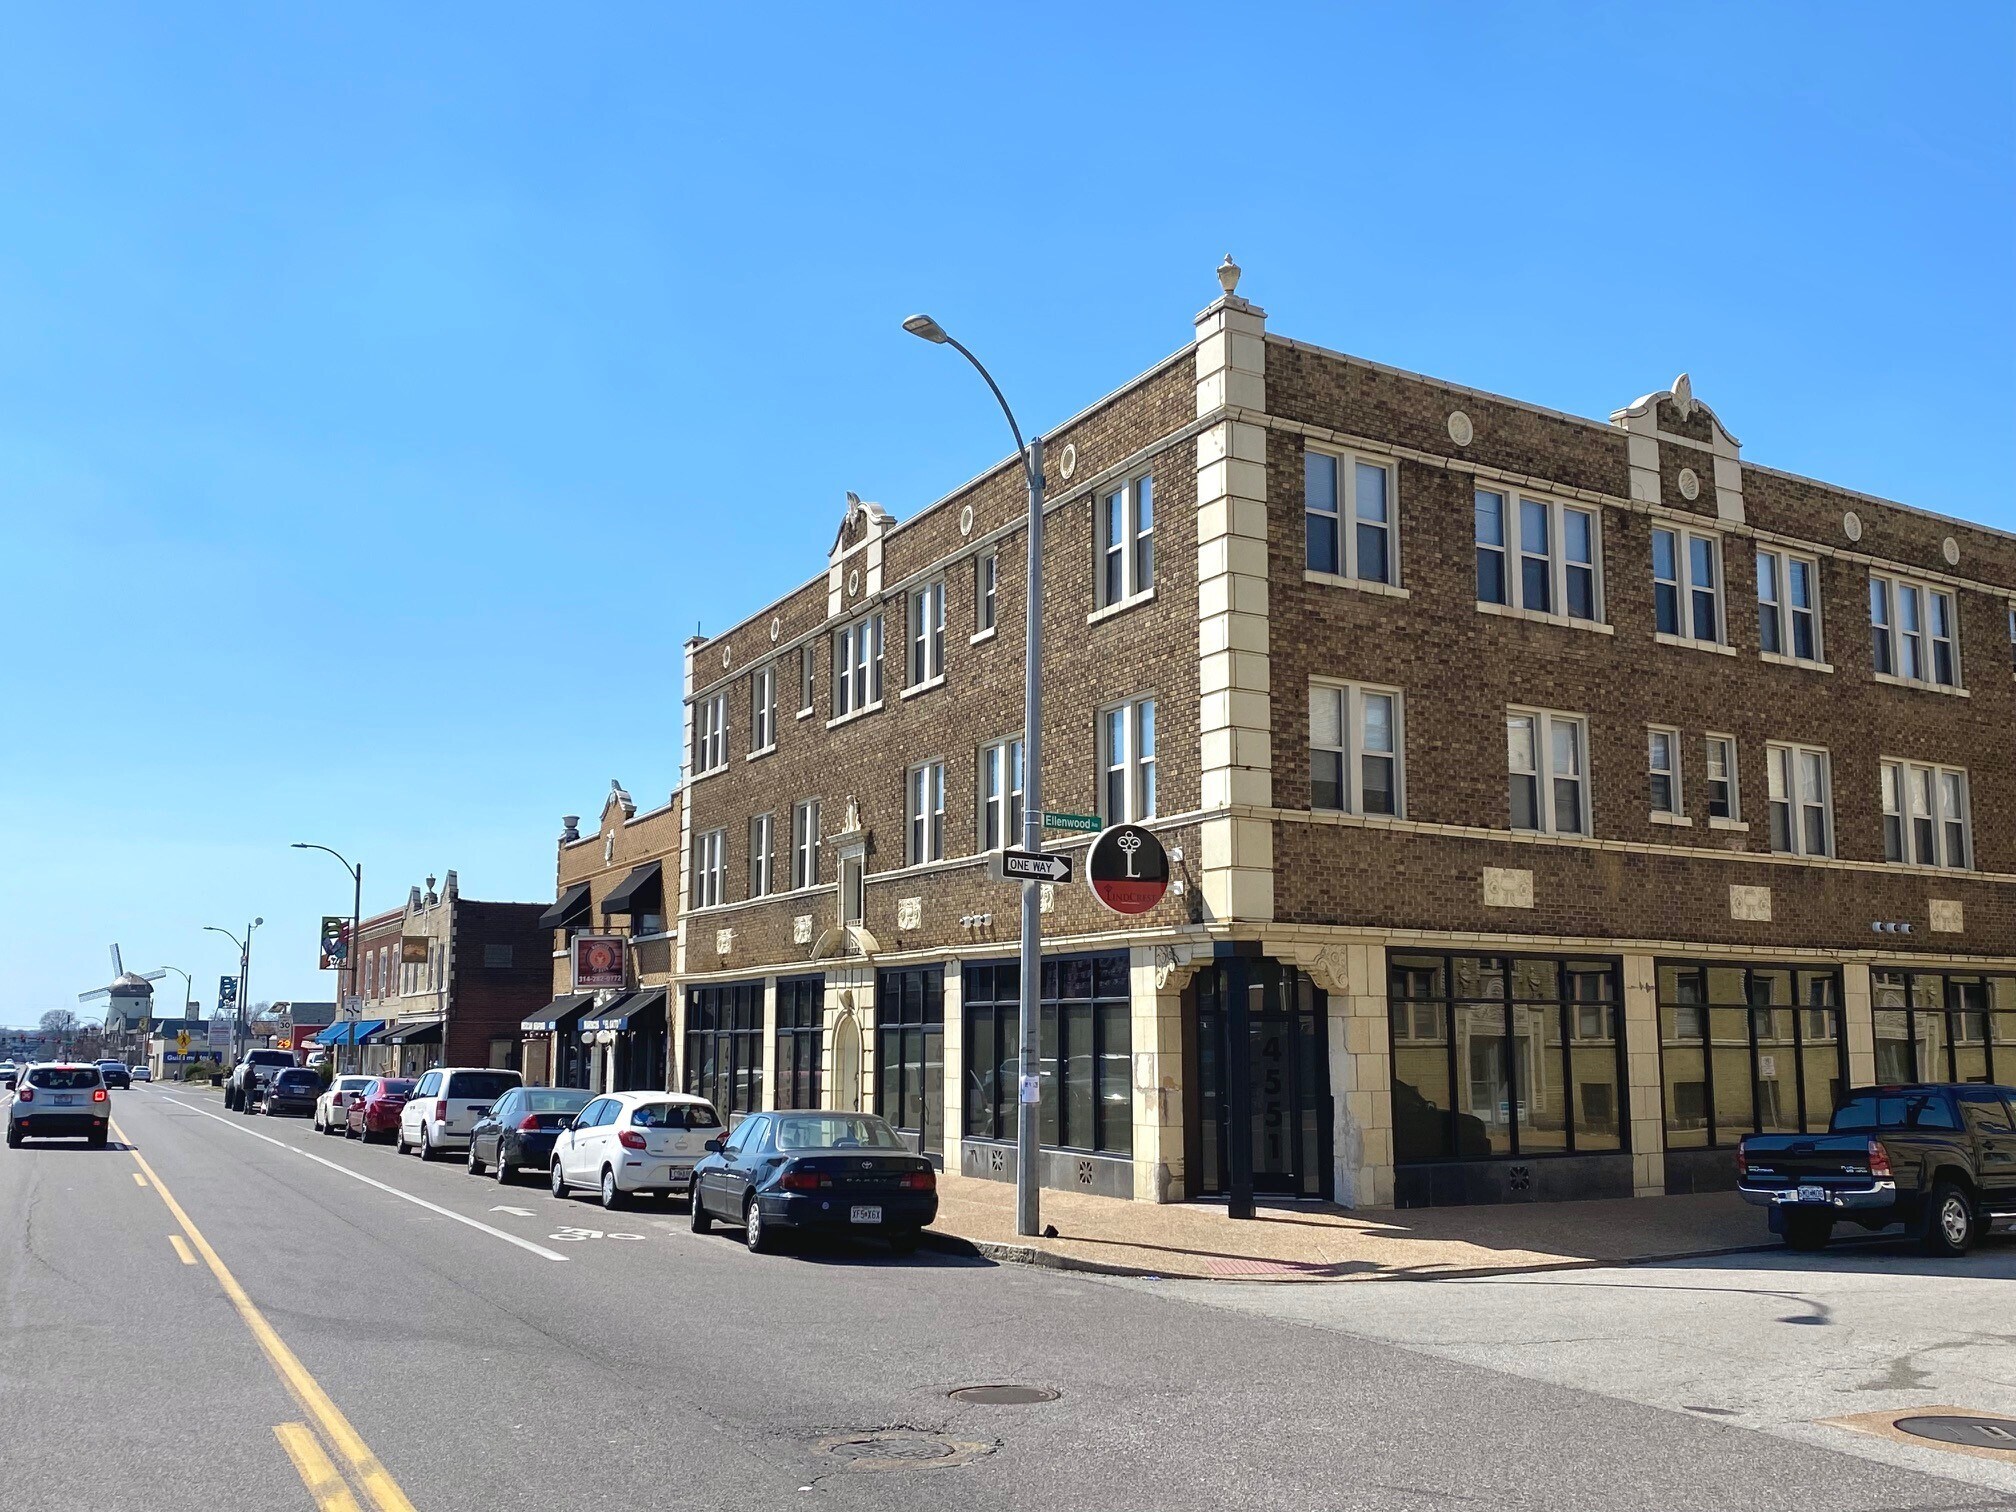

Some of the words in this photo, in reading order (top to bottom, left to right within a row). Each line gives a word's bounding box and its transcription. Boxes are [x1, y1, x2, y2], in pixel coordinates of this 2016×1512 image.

[1045, 814, 1091, 829] Ellenwood
[1010, 859, 1030, 871] ONE
[1032, 861, 1053, 873] WAY
[277, 1039, 291, 1048] 29
[1261, 1036, 1283, 1160] 4551
